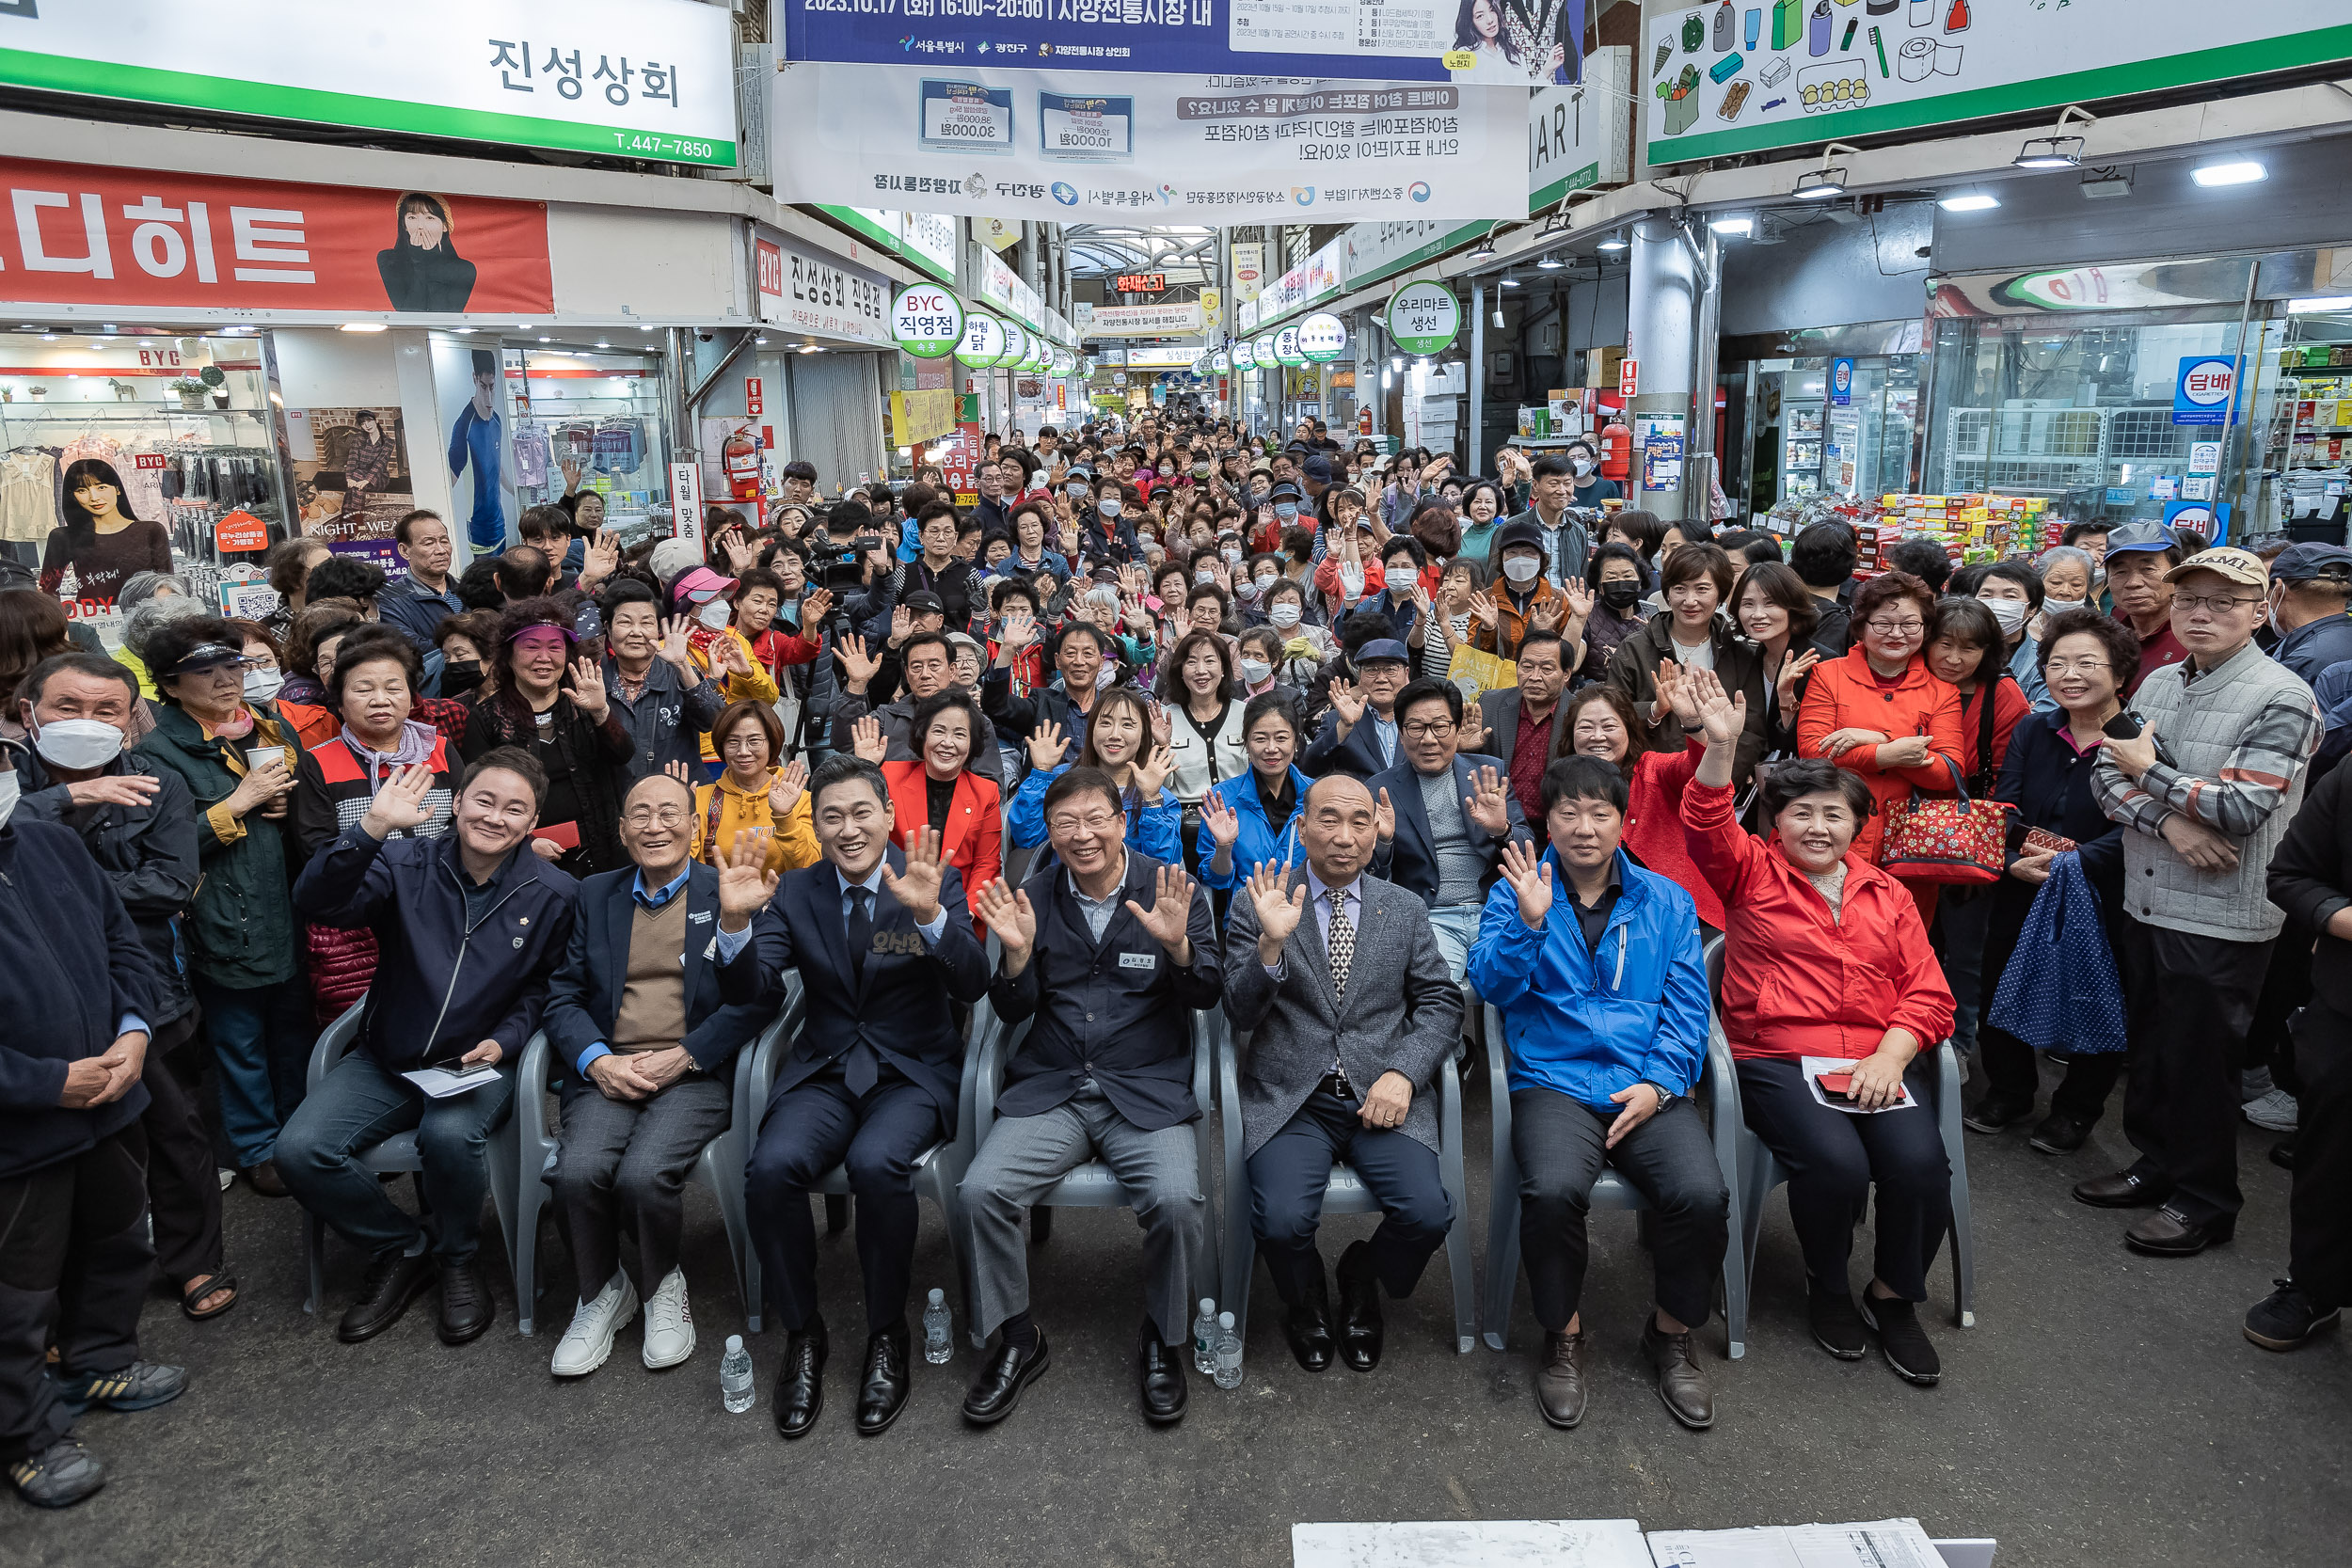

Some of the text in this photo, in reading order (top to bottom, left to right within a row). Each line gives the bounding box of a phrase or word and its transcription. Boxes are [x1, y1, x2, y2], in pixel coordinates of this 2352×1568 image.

[1057, 0, 1186, 25] 자양전통시장
[1192, 0, 1212, 26] 내
[1236, 3, 1258, 11] 2023년
[1259, 4, 1271, 12] 10월
[1292, 5, 1304, 13] 10월
[1305, 5, 1316, 14] 17일
[1236, 28, 1257, 38] 2023년
[1258, 29, 1270, 38] 10월
[1271, 29, 1283, 39] 17일
[914, 40, 964, 54] 서울특별시
[994, 42, 1028, 54] 광진구
[1055, 44, 1131, 58] 자양전통시장 상인회
[489, 38, 679, 108] 진성상회
[613, 132, 712, 160] T.447-7850
[1564, 168, 1592, 192] T.444-0772
[0, 189, 317, 285] 디히트
[759, 248, 779, 292] BYC
[791, 255, 881, 320] 진성상회 직영점
[907, 295, 944, 311] BYC
[1156, 307, 1174, 315] 못하는
[1174, 306, 1193, 314] 당신이!
[1397, 297, 1451, 314] 우리마트
[899, 315, 953, 336] 직영점
[968, 320, 988, 334] 하림
[1103, 317, 1140, 327] 자양전통시장
[1141, 316, 1161, 325] 질서를
[1411, 315, 1437, 332] 생선
[916, 341, 937, 353] 속옷
[971, 334, 985, 352] 닭
[1416, 338, 1432, 349] 생선
[139, 350, 181, 366] BYC
[1837, 370, 1849, 382] 담배
[2189, 373, 2232, 391] 담배
[138, 456, 163, 467] BYC
[944, 454, 967, 469] 오리
[677, 469, 694, 539] 타월 맞춤
[220, 531, 263, 540] 온누리상품권
[310, 522, 358, 536] NIGHT
[86, 568, 120, 587] 부탁해!
